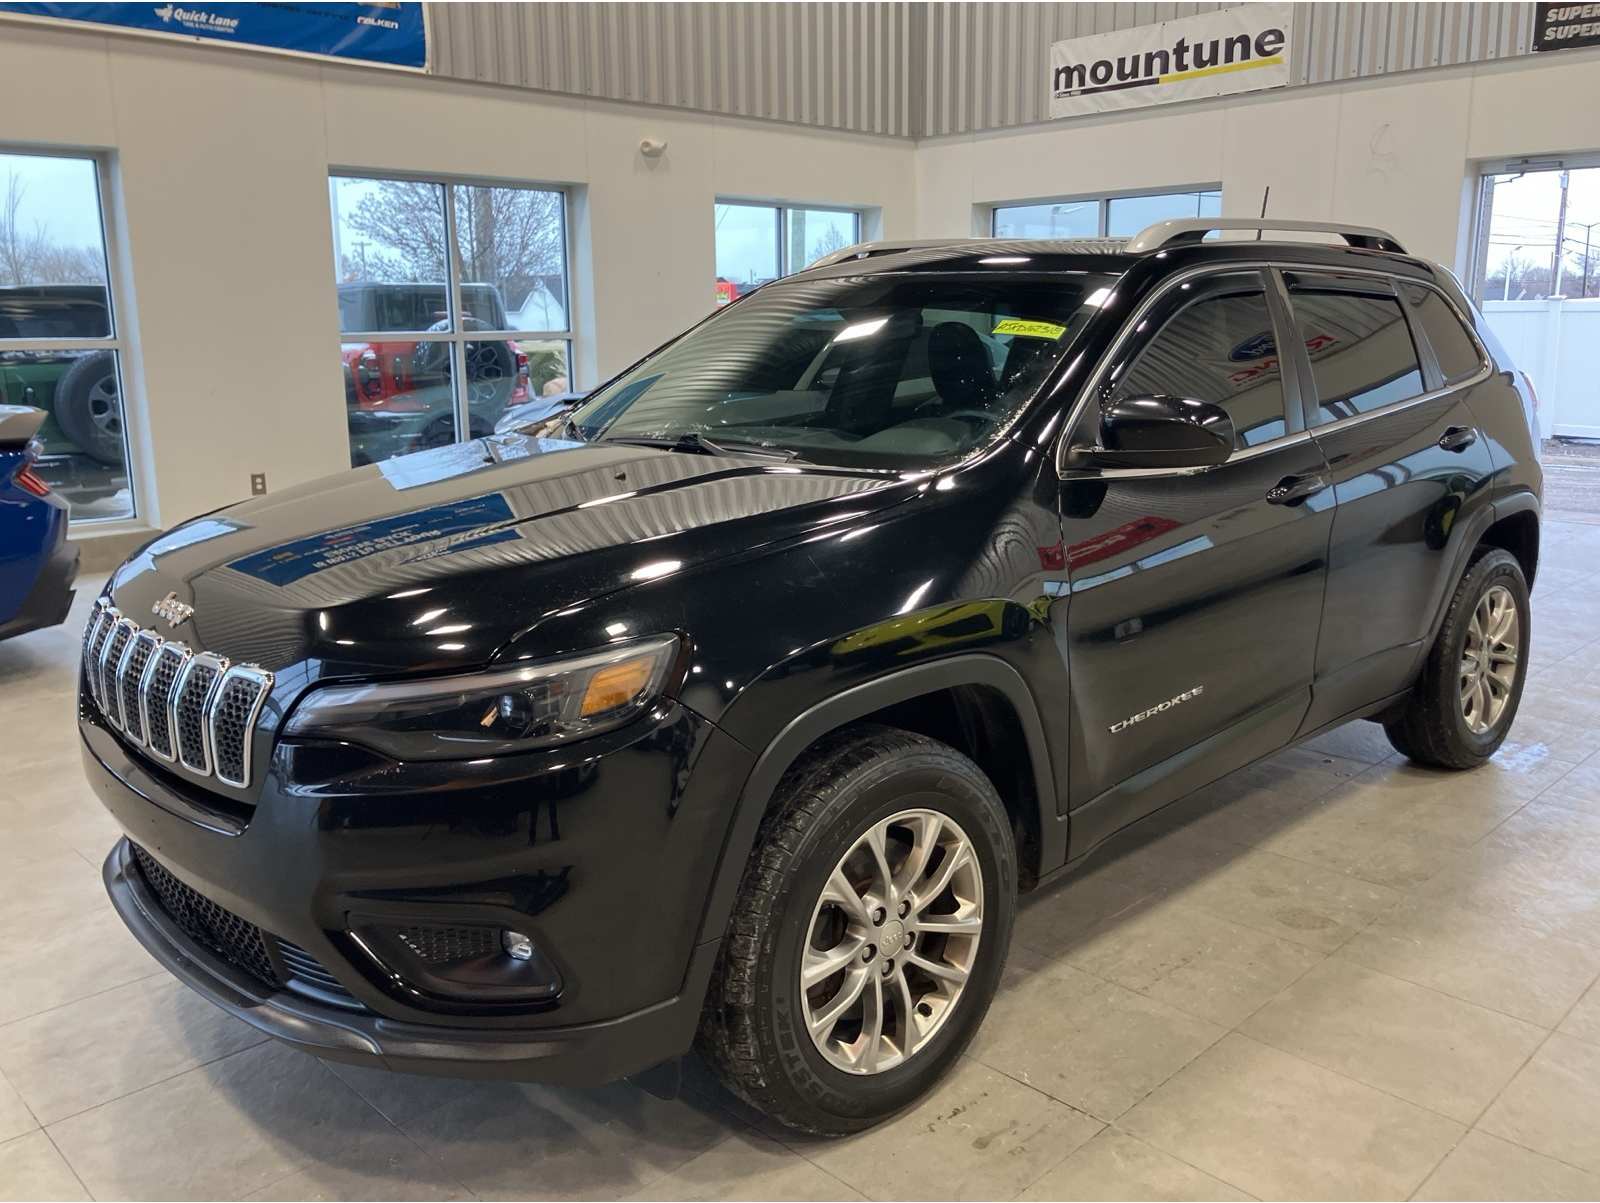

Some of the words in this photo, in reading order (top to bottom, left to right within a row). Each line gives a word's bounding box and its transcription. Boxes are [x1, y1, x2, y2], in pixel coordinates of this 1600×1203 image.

[174, 8, 208, 23] Quick
[208, 13, 240, 28] Lane
[1543, 22, 1600, 40] SUPER
[1053, 28, 1285, 92] mountune
[1109, 685, 1204, 734] CHEROKEE
